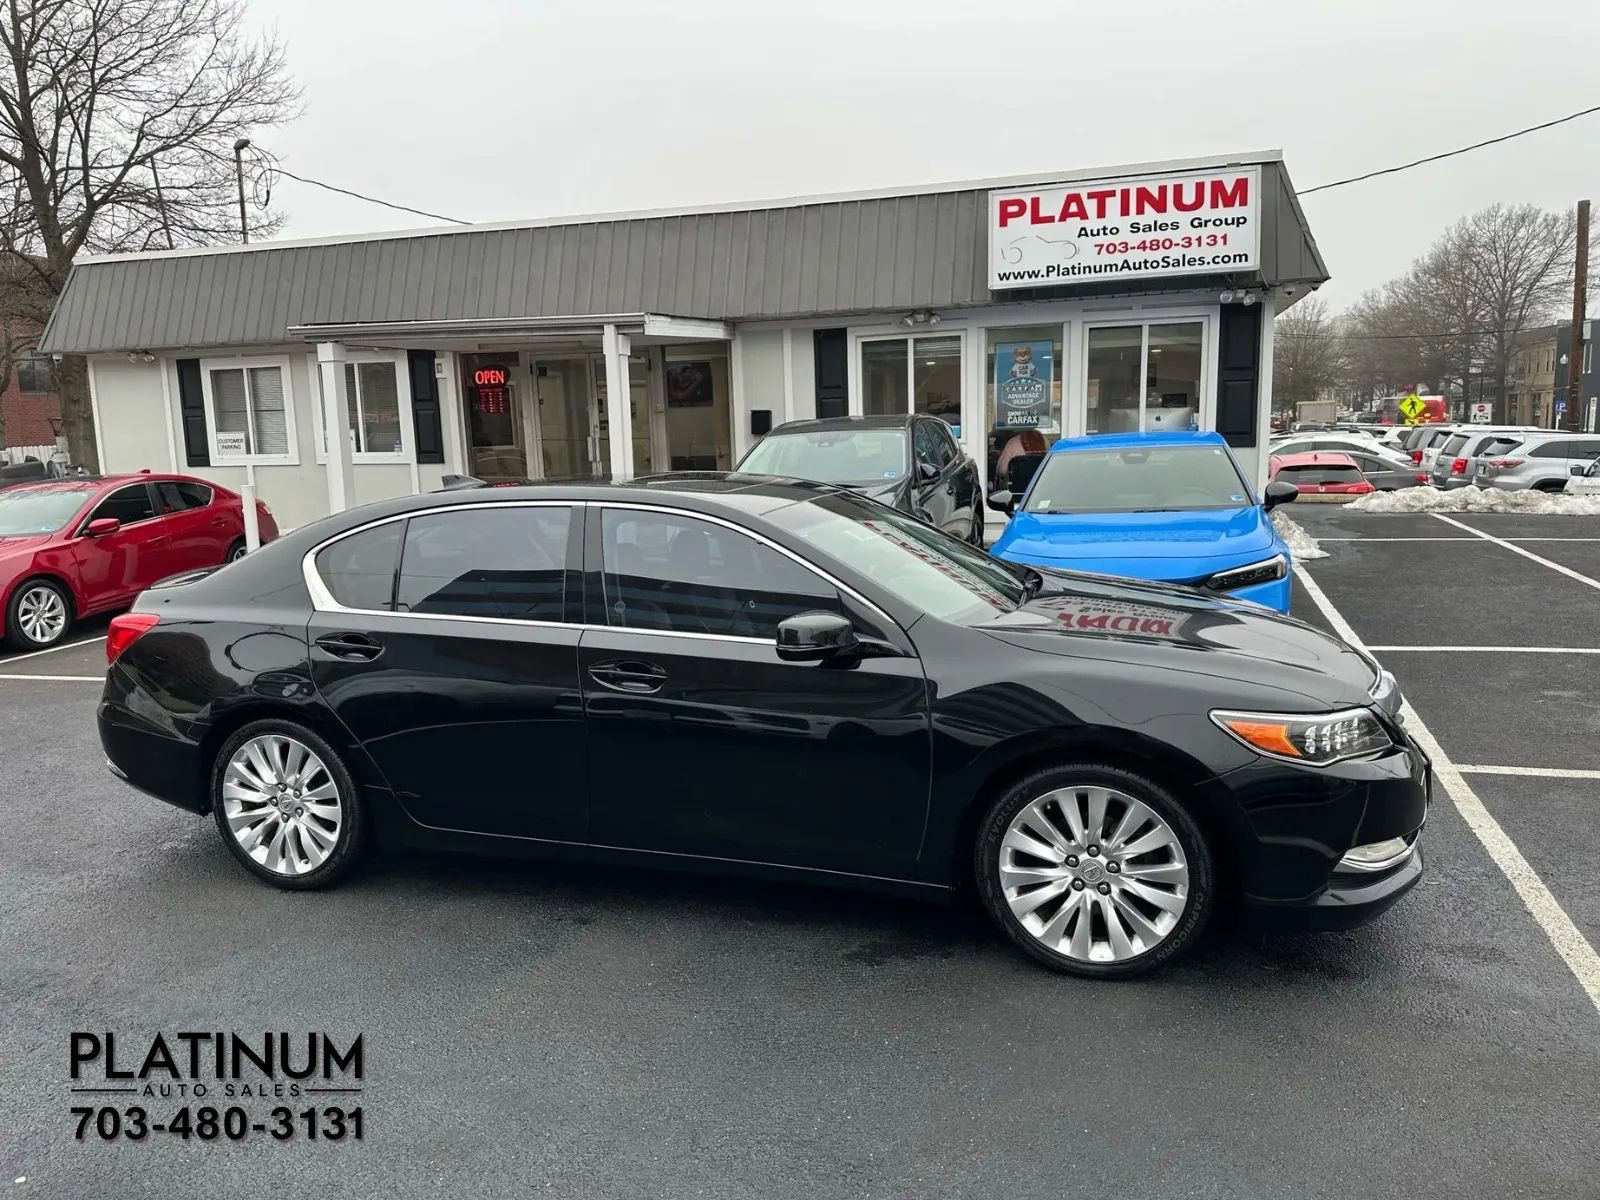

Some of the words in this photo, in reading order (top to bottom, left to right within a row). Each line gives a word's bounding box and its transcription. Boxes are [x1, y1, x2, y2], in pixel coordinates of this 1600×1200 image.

[998, 177, 1249, 228] PLATINUM
[1077, 226, 1120, 239] Auto
[1129, 219, 1180, 234] Sales
[1190, 215, 1248, 230] Group
[1094, 233, 1229, 256] 703-480-3131
[997, 250, 1250, 282] www.PlatinumAutoSales.com
[475, 370, 504, 385] OPEN
[1007, 416, 1038, 425] CARFAX
[1156, 892, 1205, 961] CAPRICORN
